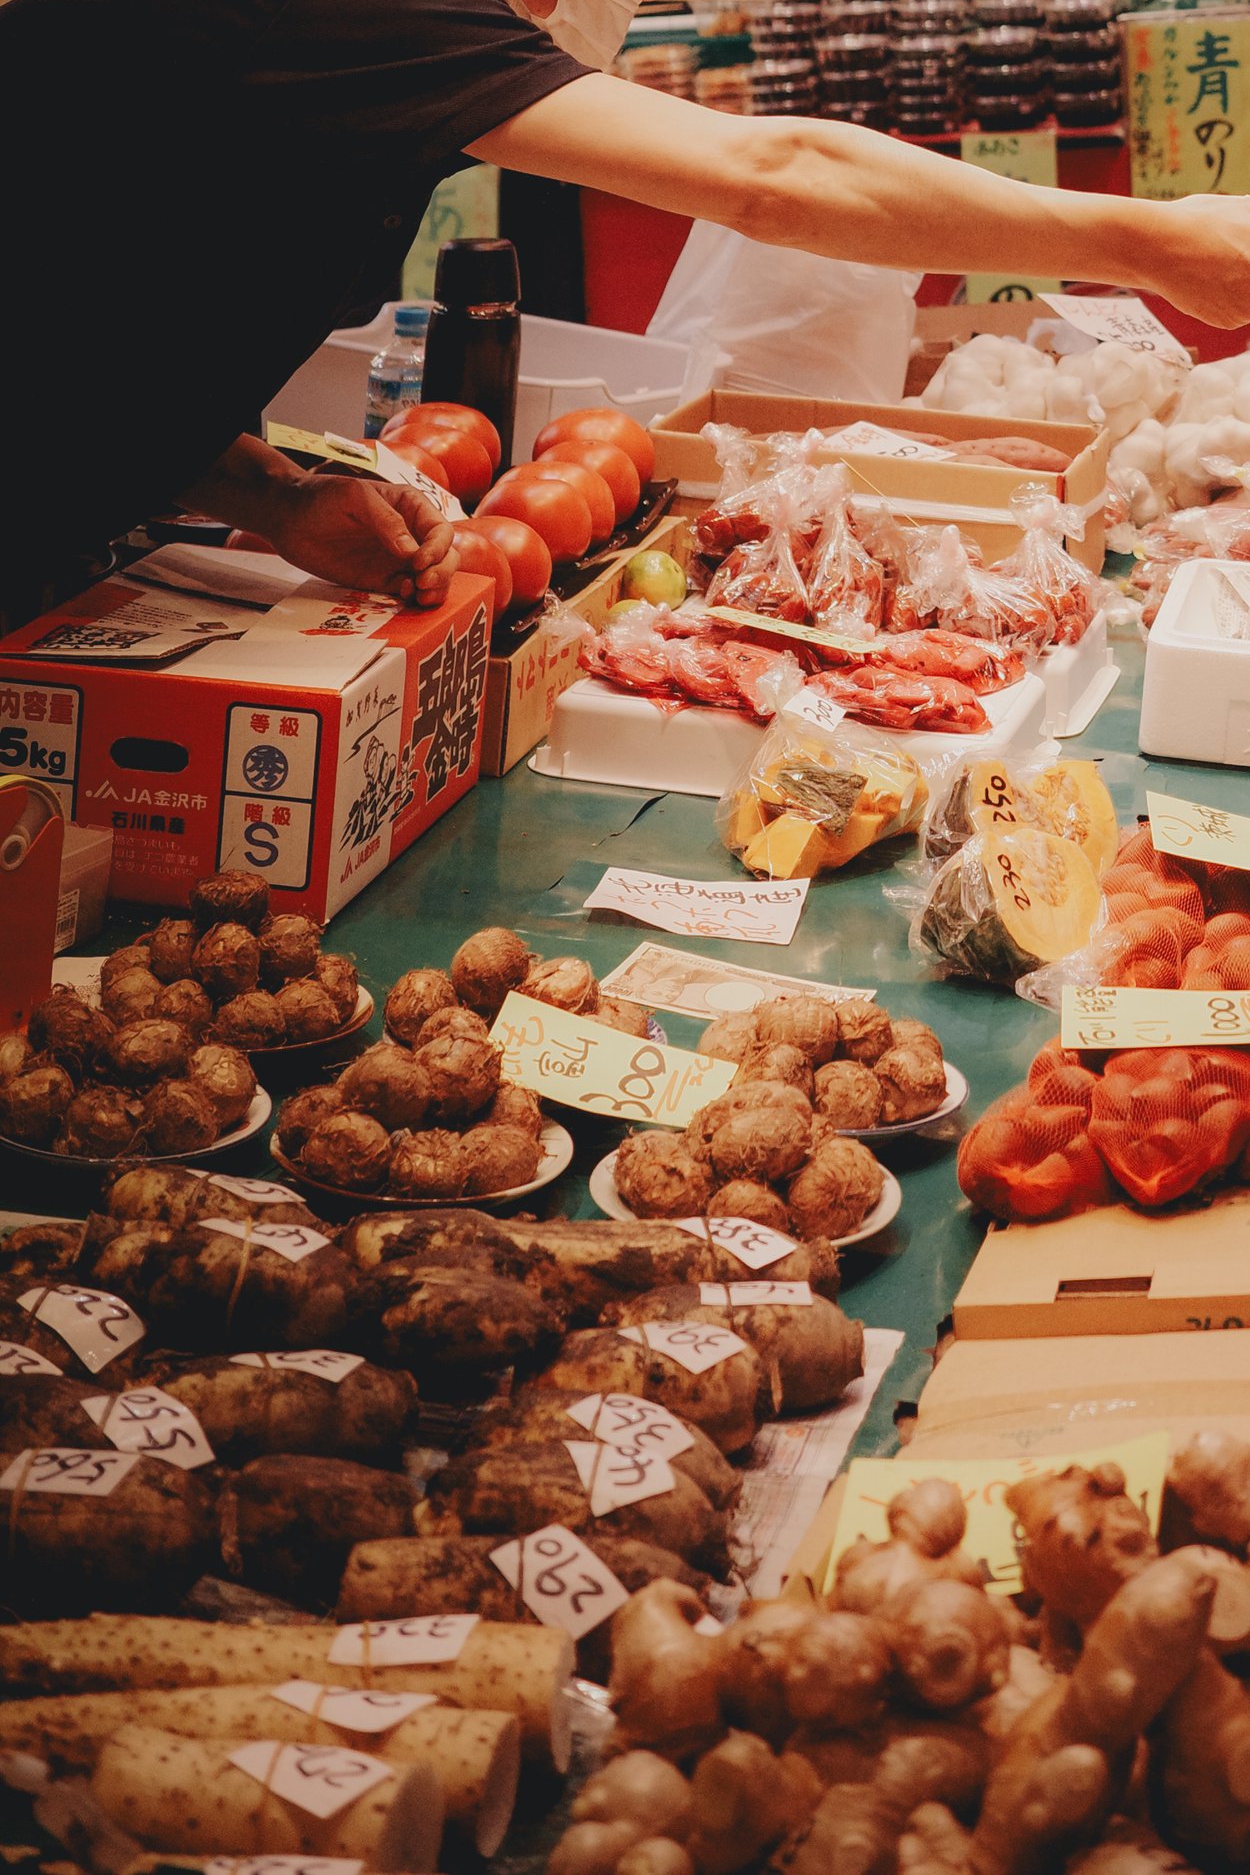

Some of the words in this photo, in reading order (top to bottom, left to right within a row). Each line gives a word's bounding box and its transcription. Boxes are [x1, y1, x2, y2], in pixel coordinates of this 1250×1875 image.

[1186, 30, 1241, 191] 青のり
[0, 687, 74, 726] 内容量
[250, 712, 300, 738] 等級
[0, 727, 66, 775] 5kg
[123, 785, 208, 812] JA金沢市
[243, 802, 292, 827] 階級
[982, 774, 1017, 824] 250
[111, 810, 186, 836] 石川県産
[243, 821, 280, 868] S
[996, 853, 1033, 912] 230
[578, 1045, 667, 1118] 300
[30, 1453, 117, 1485] 560
[534, 1539, 604, 1614] 290
